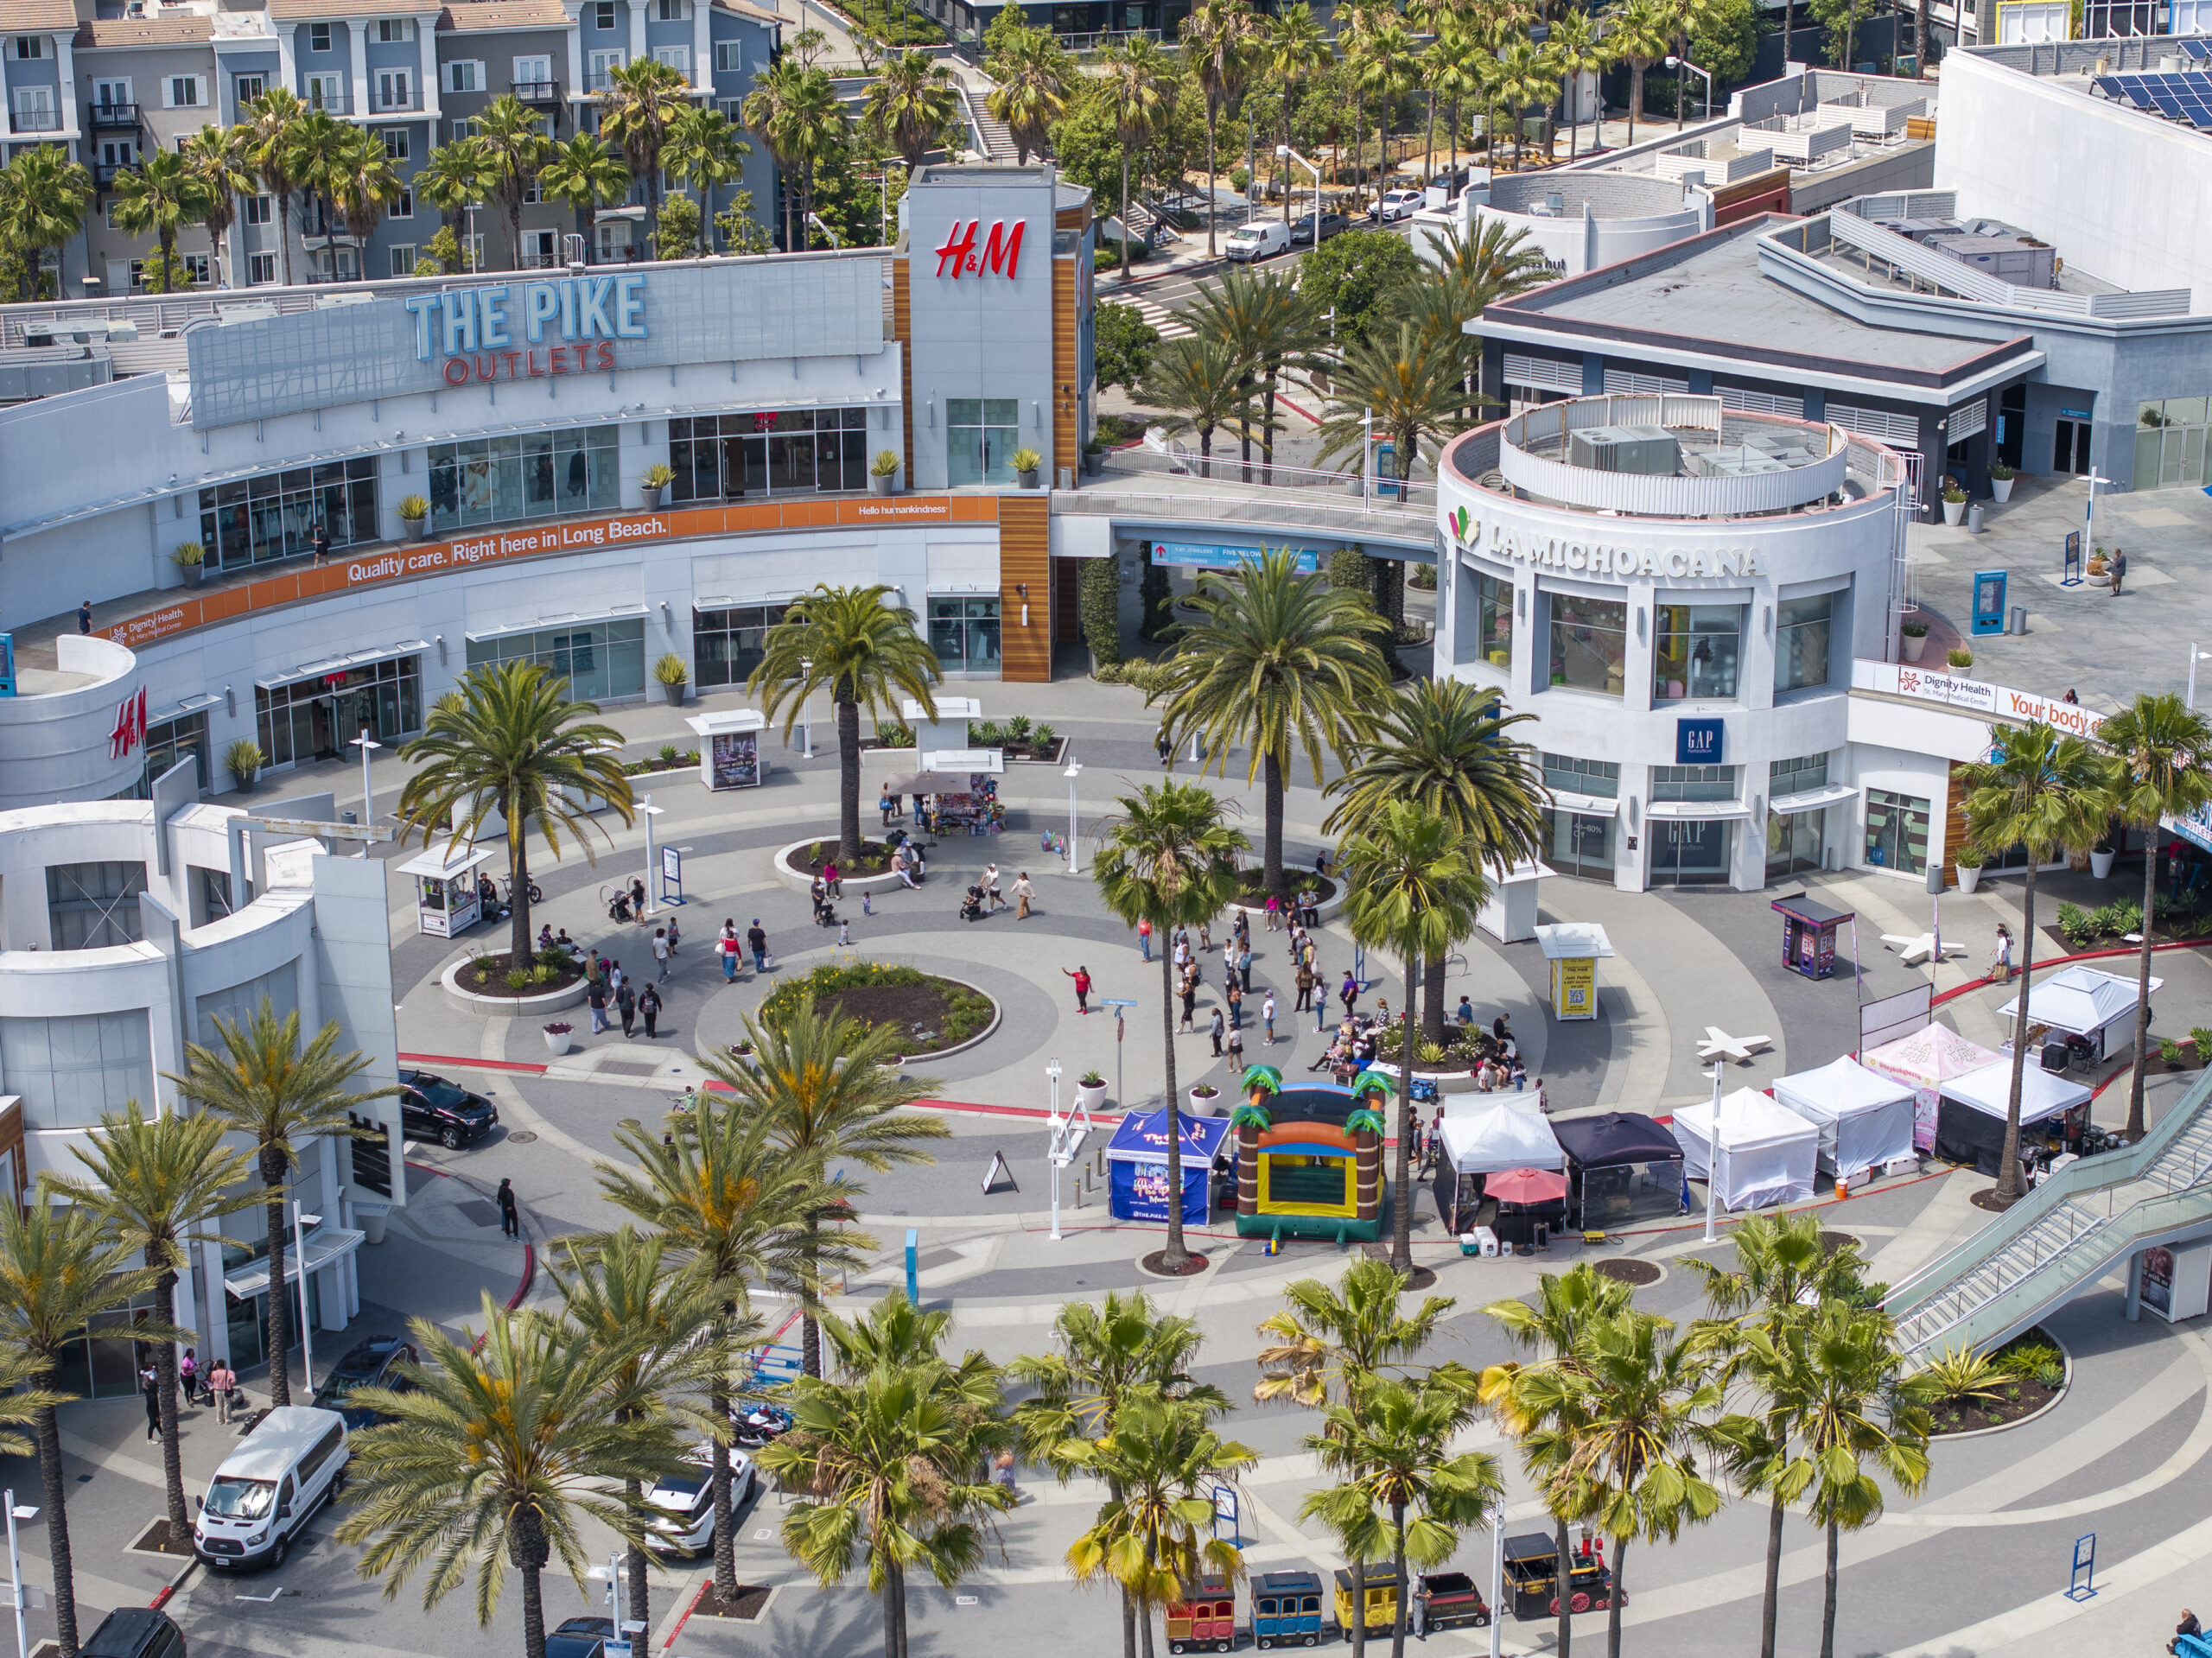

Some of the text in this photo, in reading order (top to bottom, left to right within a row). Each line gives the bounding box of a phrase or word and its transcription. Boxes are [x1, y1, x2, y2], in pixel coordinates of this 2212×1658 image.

[935, 219, 1026, 280] H&M
[406, 273, 648, 361] THE PIKE
[442, 341, 616, 385] OUTLETS
[859, 505, 947, 515] Hello humankindness
[349, 518, 667, 581] Quality care. Right here in Long Beach.
[1487, 521, 1768, 579] LA MICHOACANA
[129, 618, 156, 632] Dignity
[1925, 675, 1959, 691] Dignity
[107, 683, 147, 760] H&M
[2010, 693, 2045, 718] Your
[2049, 703, 2088, 734] body
[1688, 730, 1713, 749] GAP
[1667, 820, 1707, 843] GAP
